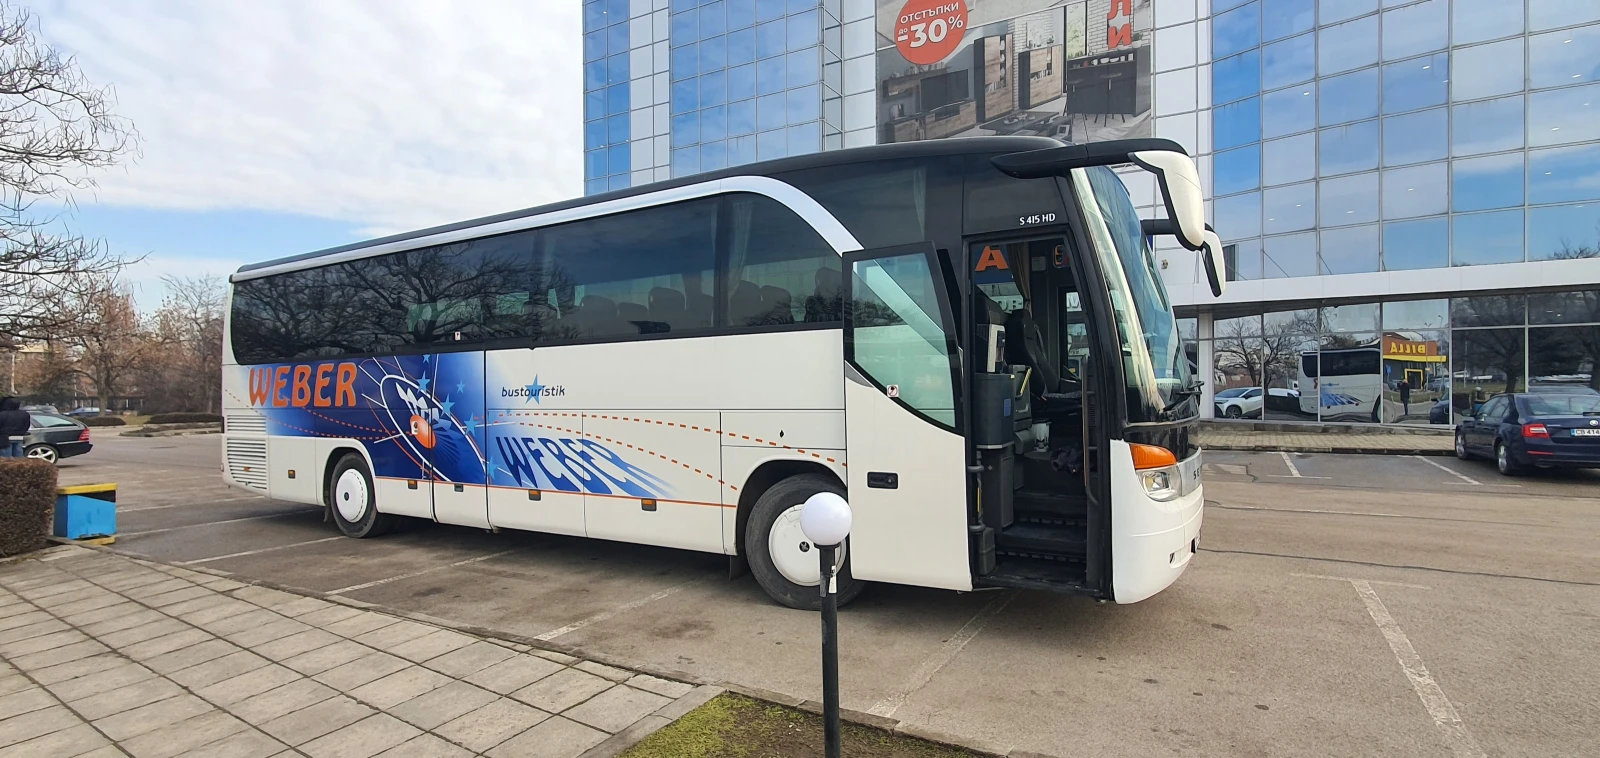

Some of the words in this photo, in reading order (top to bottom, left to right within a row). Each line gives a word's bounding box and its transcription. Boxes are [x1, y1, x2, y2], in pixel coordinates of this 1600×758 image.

[900, 1, 959, 24] ОТСТЪПКИ
[897, 13, 964, 48] -30%
[1019, 216, 1026, 226] S
[1026, 214, 1041, 225] 415
[1041, 212, 1056, 223] HD
[248, 362, 358, 408] WEBER
[501, 385, 566, 397] bustouristik
[495, 436, 678, 499] WEBER
